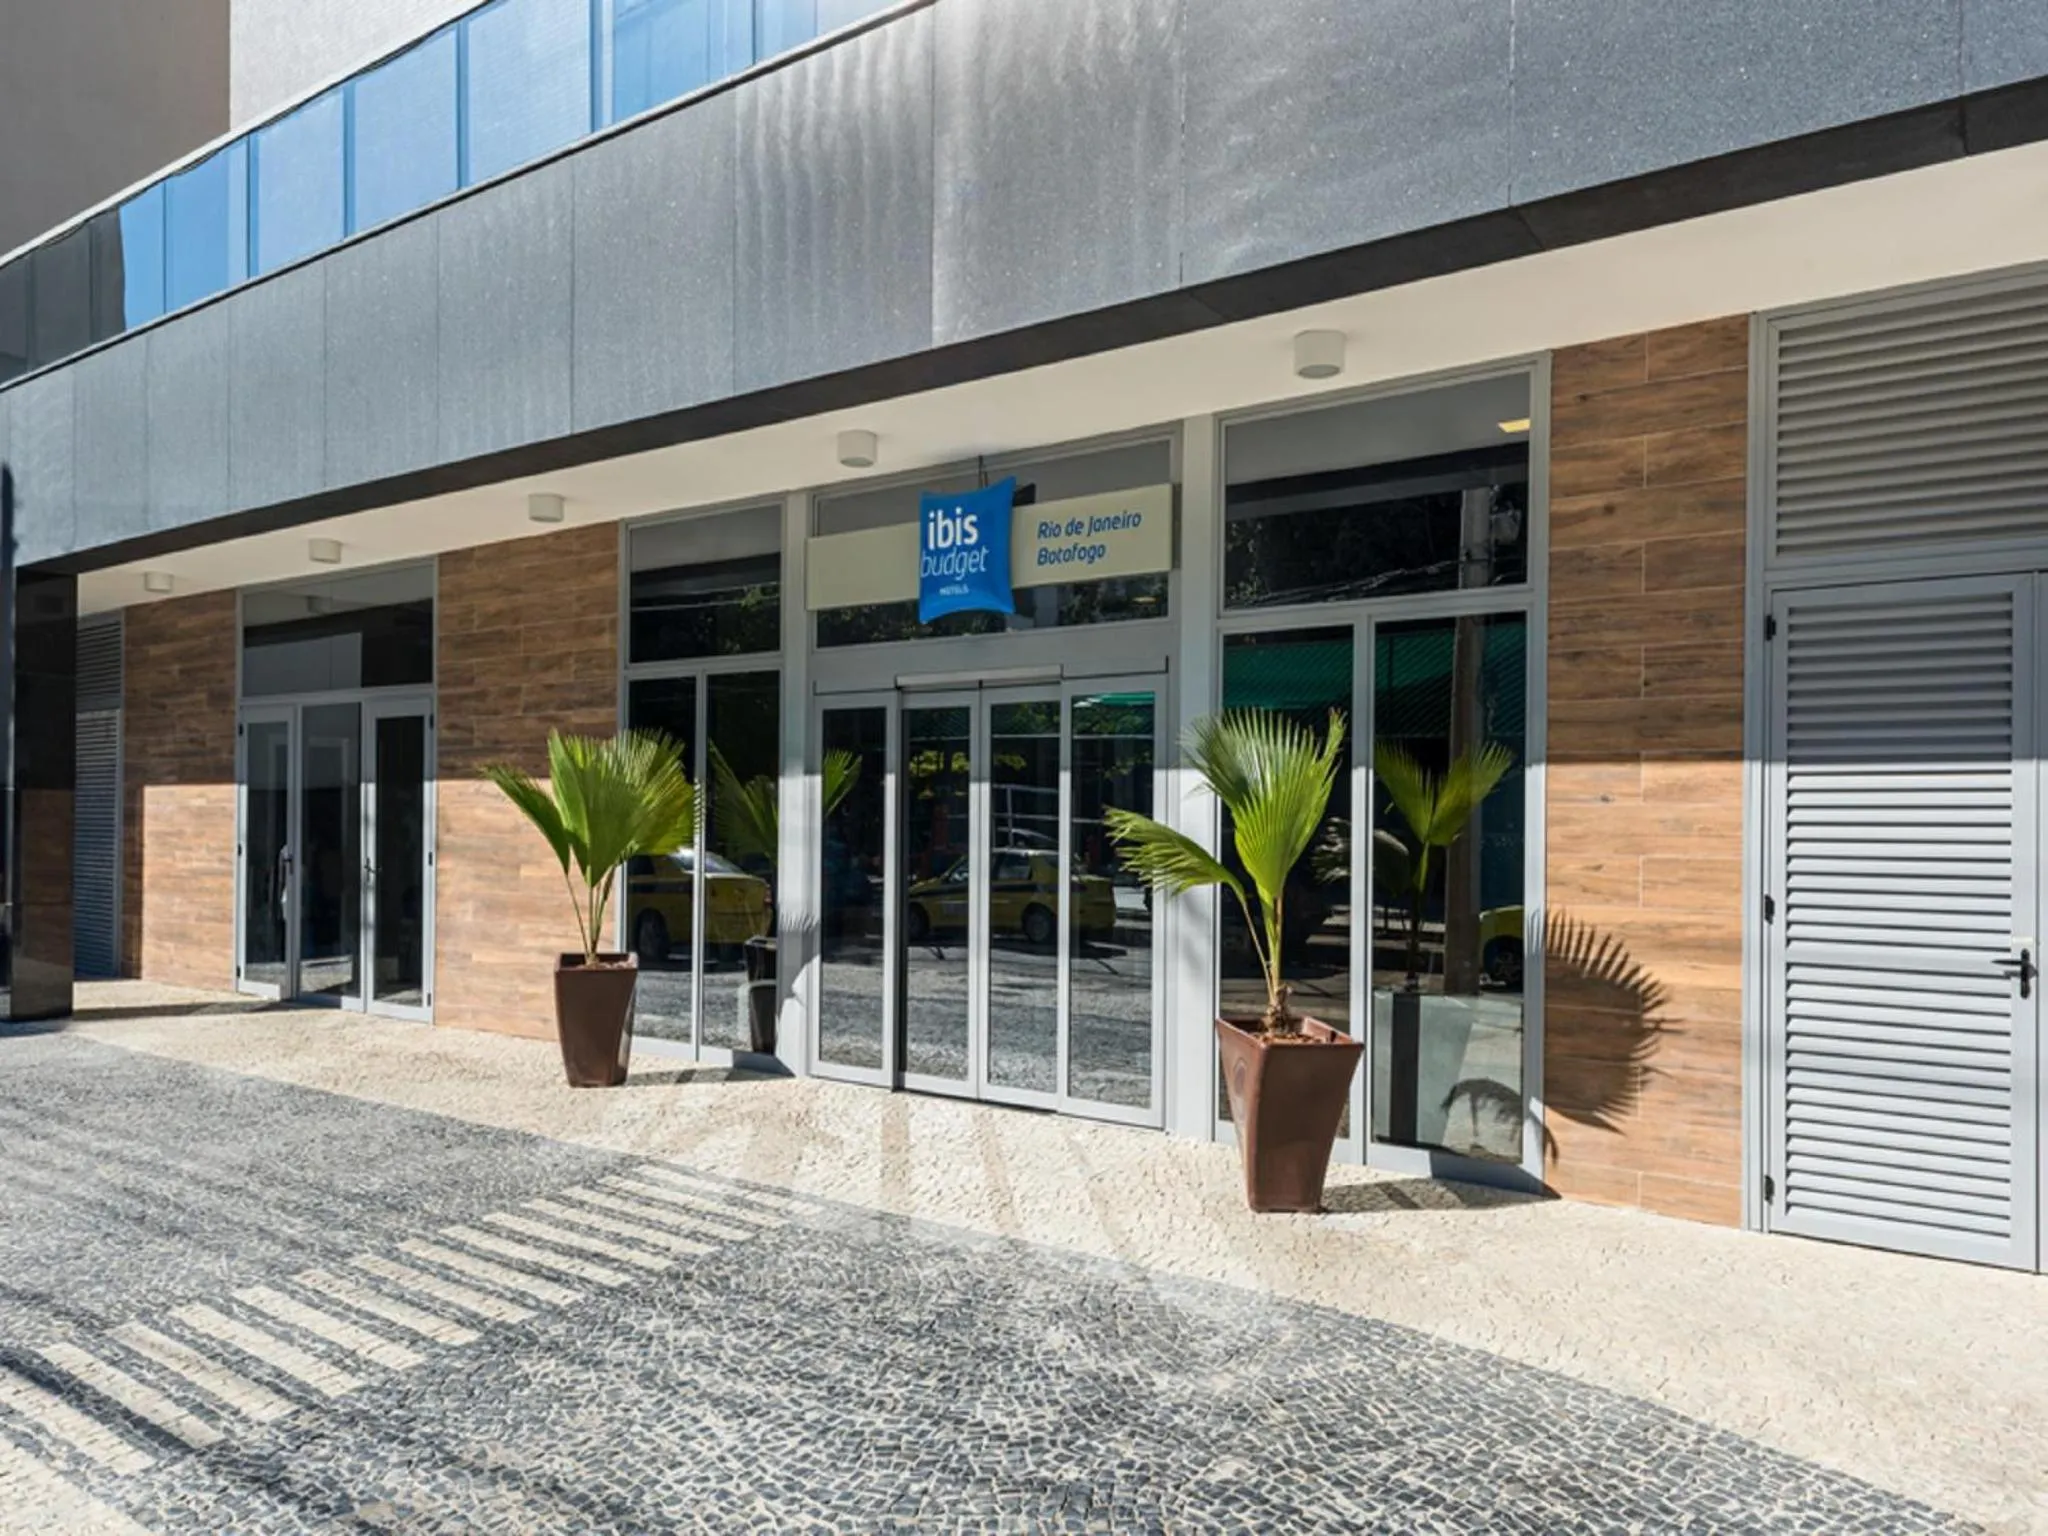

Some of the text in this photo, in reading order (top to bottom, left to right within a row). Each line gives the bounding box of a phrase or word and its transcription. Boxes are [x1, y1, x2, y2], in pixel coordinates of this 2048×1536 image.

[928, 506, 979, 550] ibis
[1037, 510, 1142, 539] Rio de Janeiro
[921, 545, 989, 581] budget
[1037, 543, 1106, 566] Botafogo
